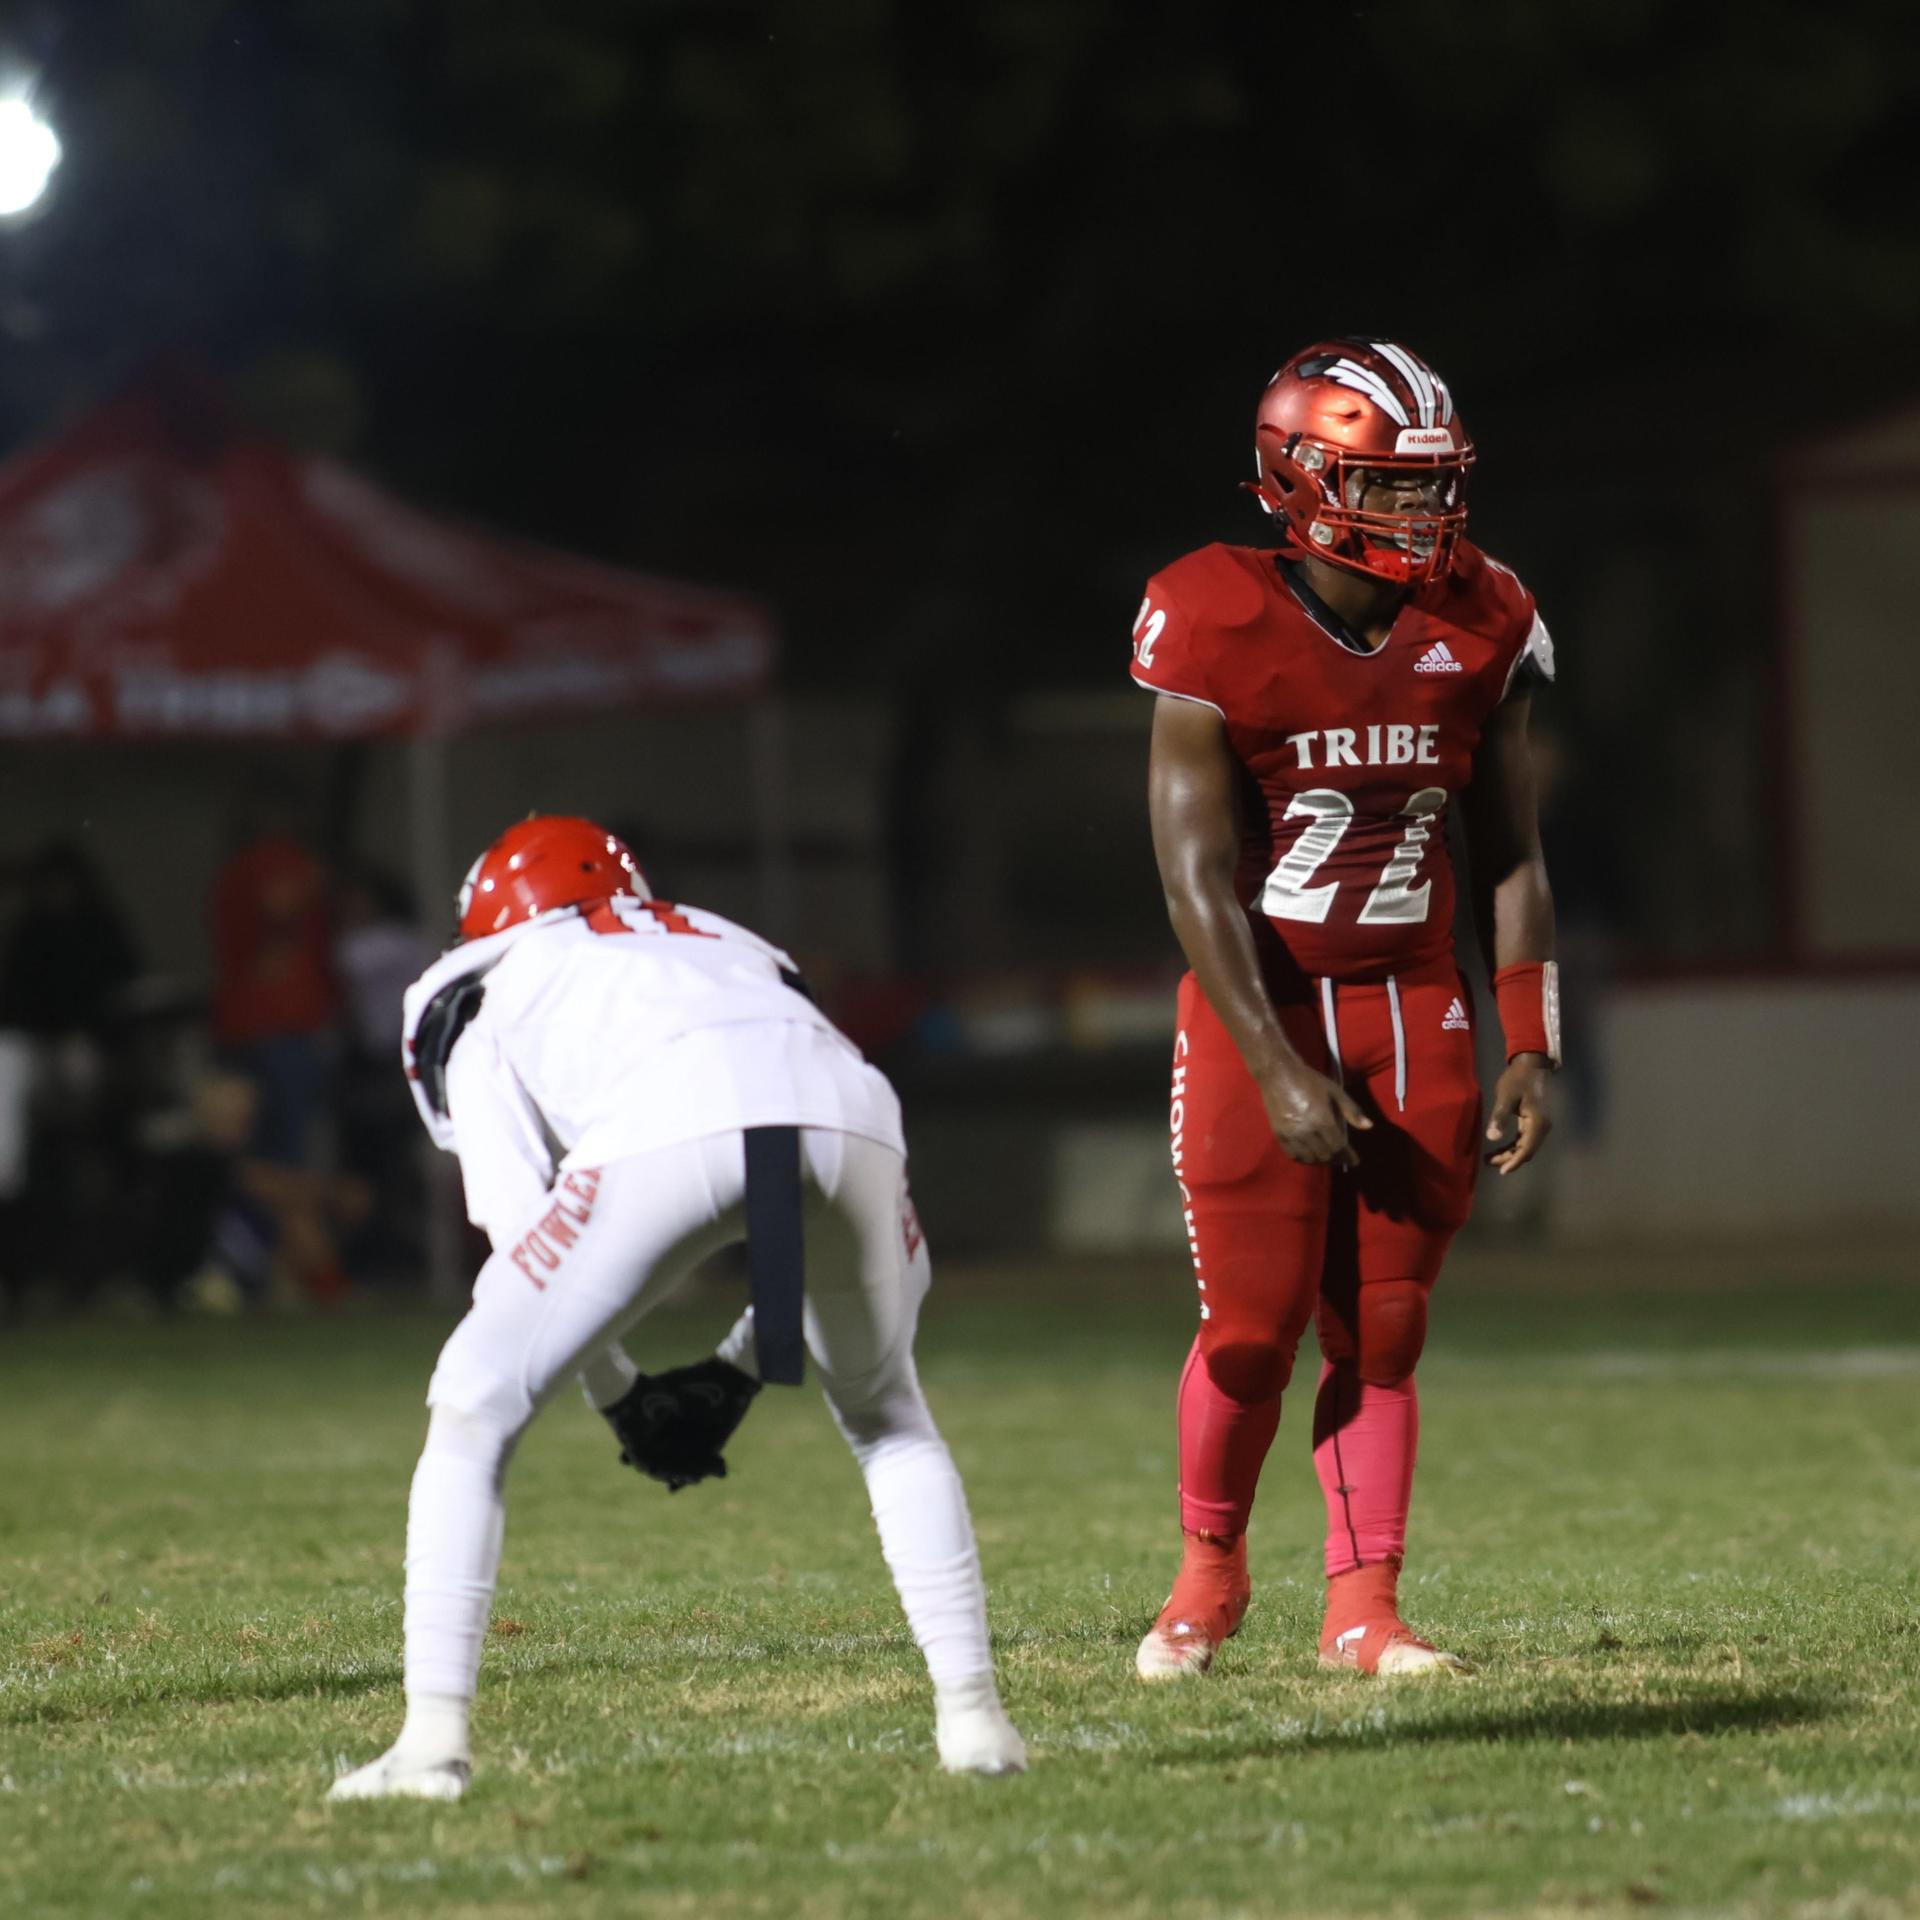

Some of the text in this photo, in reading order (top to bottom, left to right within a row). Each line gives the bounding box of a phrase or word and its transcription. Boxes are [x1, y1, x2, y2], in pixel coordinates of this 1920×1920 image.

[1413, 660, 1463, 673] adidas
[1285, 724, 1440, 770] TRIBE
[1261, 786, 1448, 925] 22
